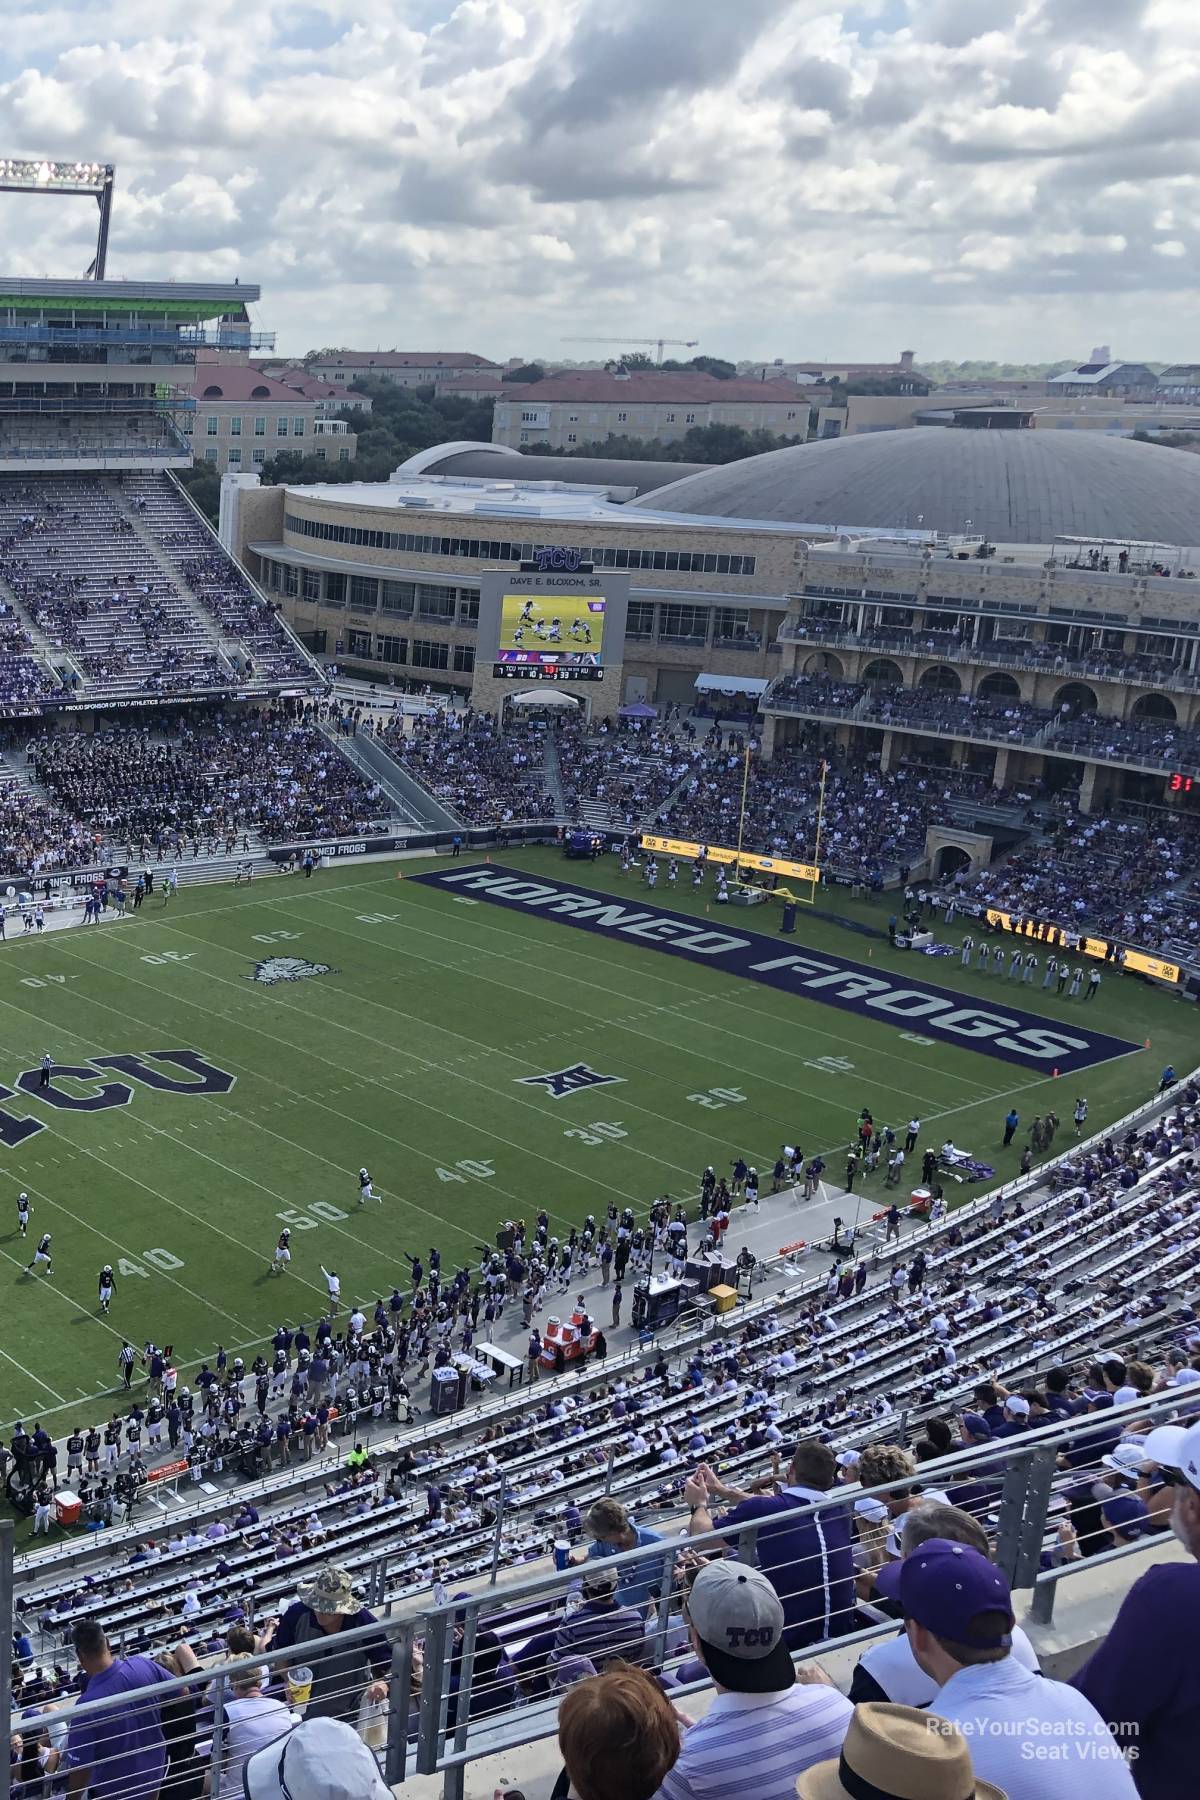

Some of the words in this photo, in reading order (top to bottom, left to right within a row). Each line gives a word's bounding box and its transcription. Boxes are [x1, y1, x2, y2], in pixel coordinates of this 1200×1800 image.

[536, 547, 581, 571] TCU
[510, 577, 533, 586] DAVE
[535, 578, 544, 586] E.
[547, 578, 586, 587] BLOXOM,
[589, 579, 602, 587] SR.
[65, 704, 84, 712] PROUD
[130, 699, 158, 707] ATHLETICS
[1170, 773, 1193, 792] 31
[338, 843, 366, 855] FROGS
[74, 872, 105, 885] FROGS
[440, 870, 752, 954] HORNED
[749, 955, 1091, 1059] FROGS
[19, 973, 67, 988] 40
[803, 1056, 855, 1074] 10
[686, 1088, 747, 1110] 20
[563, 1122, 630, 1146] 30
[434, 1160, 496, 1185] 40
[275, 1201, 349, 1231] 50
[117, 1247, 184, 1280] 40
[726, 1626, 774, 1647] TCU
